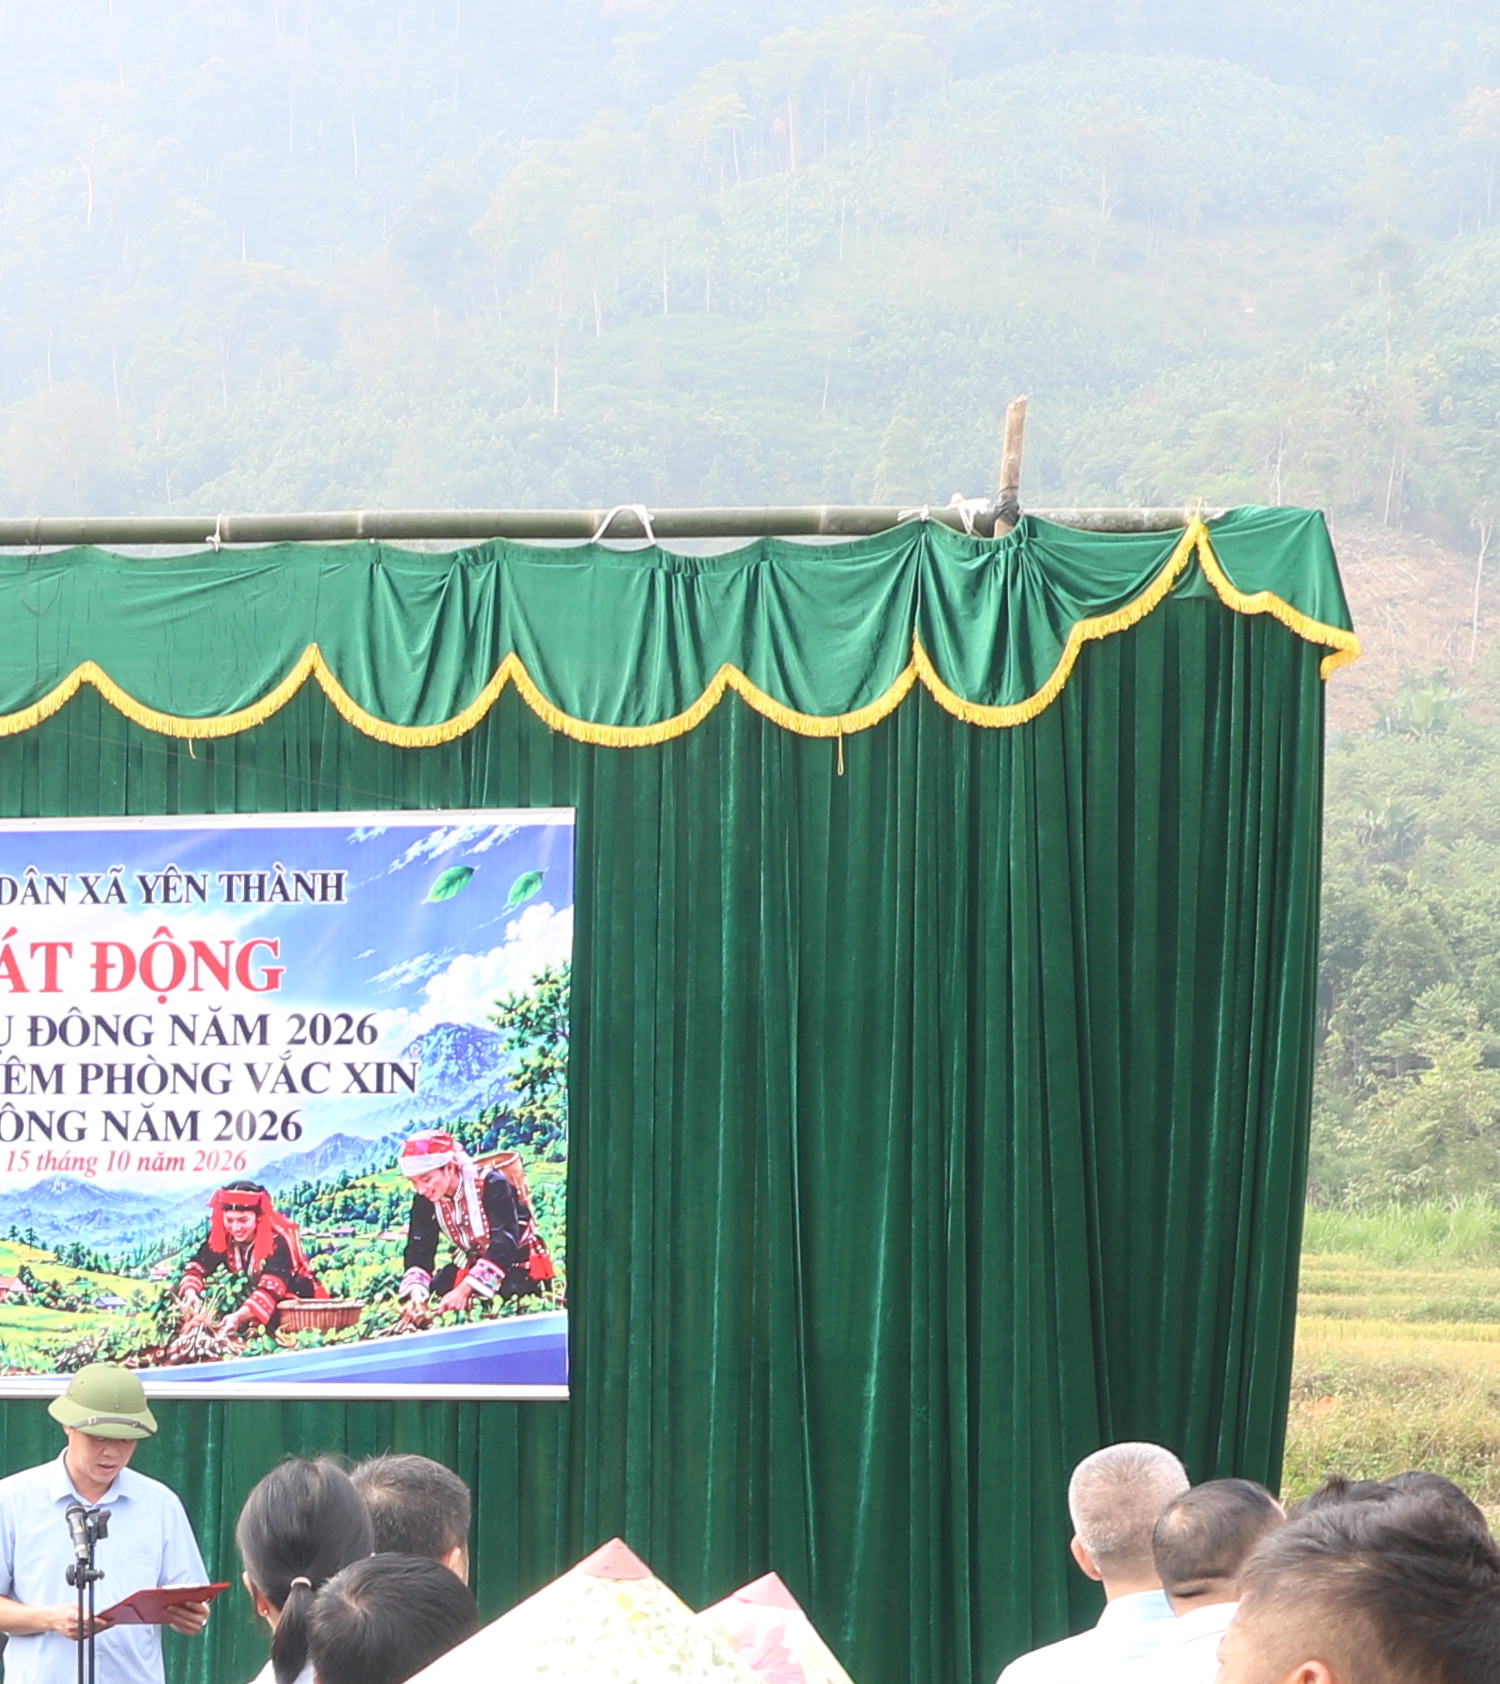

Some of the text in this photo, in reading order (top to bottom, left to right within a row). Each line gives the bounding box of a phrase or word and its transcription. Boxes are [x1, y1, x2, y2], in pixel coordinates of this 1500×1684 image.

[79, 866, 128, 904] XÃ
[138, 866, 208, 904] YÊN
[219, 864, 346, 903] THÀNH
[90, 925, 285, 1004] ĐỘNG
[27, 1006, 154, 1047] ĐÔNG
[169, 1005, 271, 1046] NĂM
[286, 1012, 378, 1046] 2026
[78, 1054, 233, 1096] PHÒNG
[244, 1049, 331, 1095] VẮC
[341, 1061, 419, 1094] XIN
[101, 1102, 202, 1142] NĂM
[213, 1109, 303, 1142] 2026
[5, 1149, 31, 1172] 15
[36, 1149, 98, 1178] tháng
[105, 1149, 131, 1172] 10
[136, 1151, 186, 1172] năm
[192, 1149, 248, 1172] 2026
